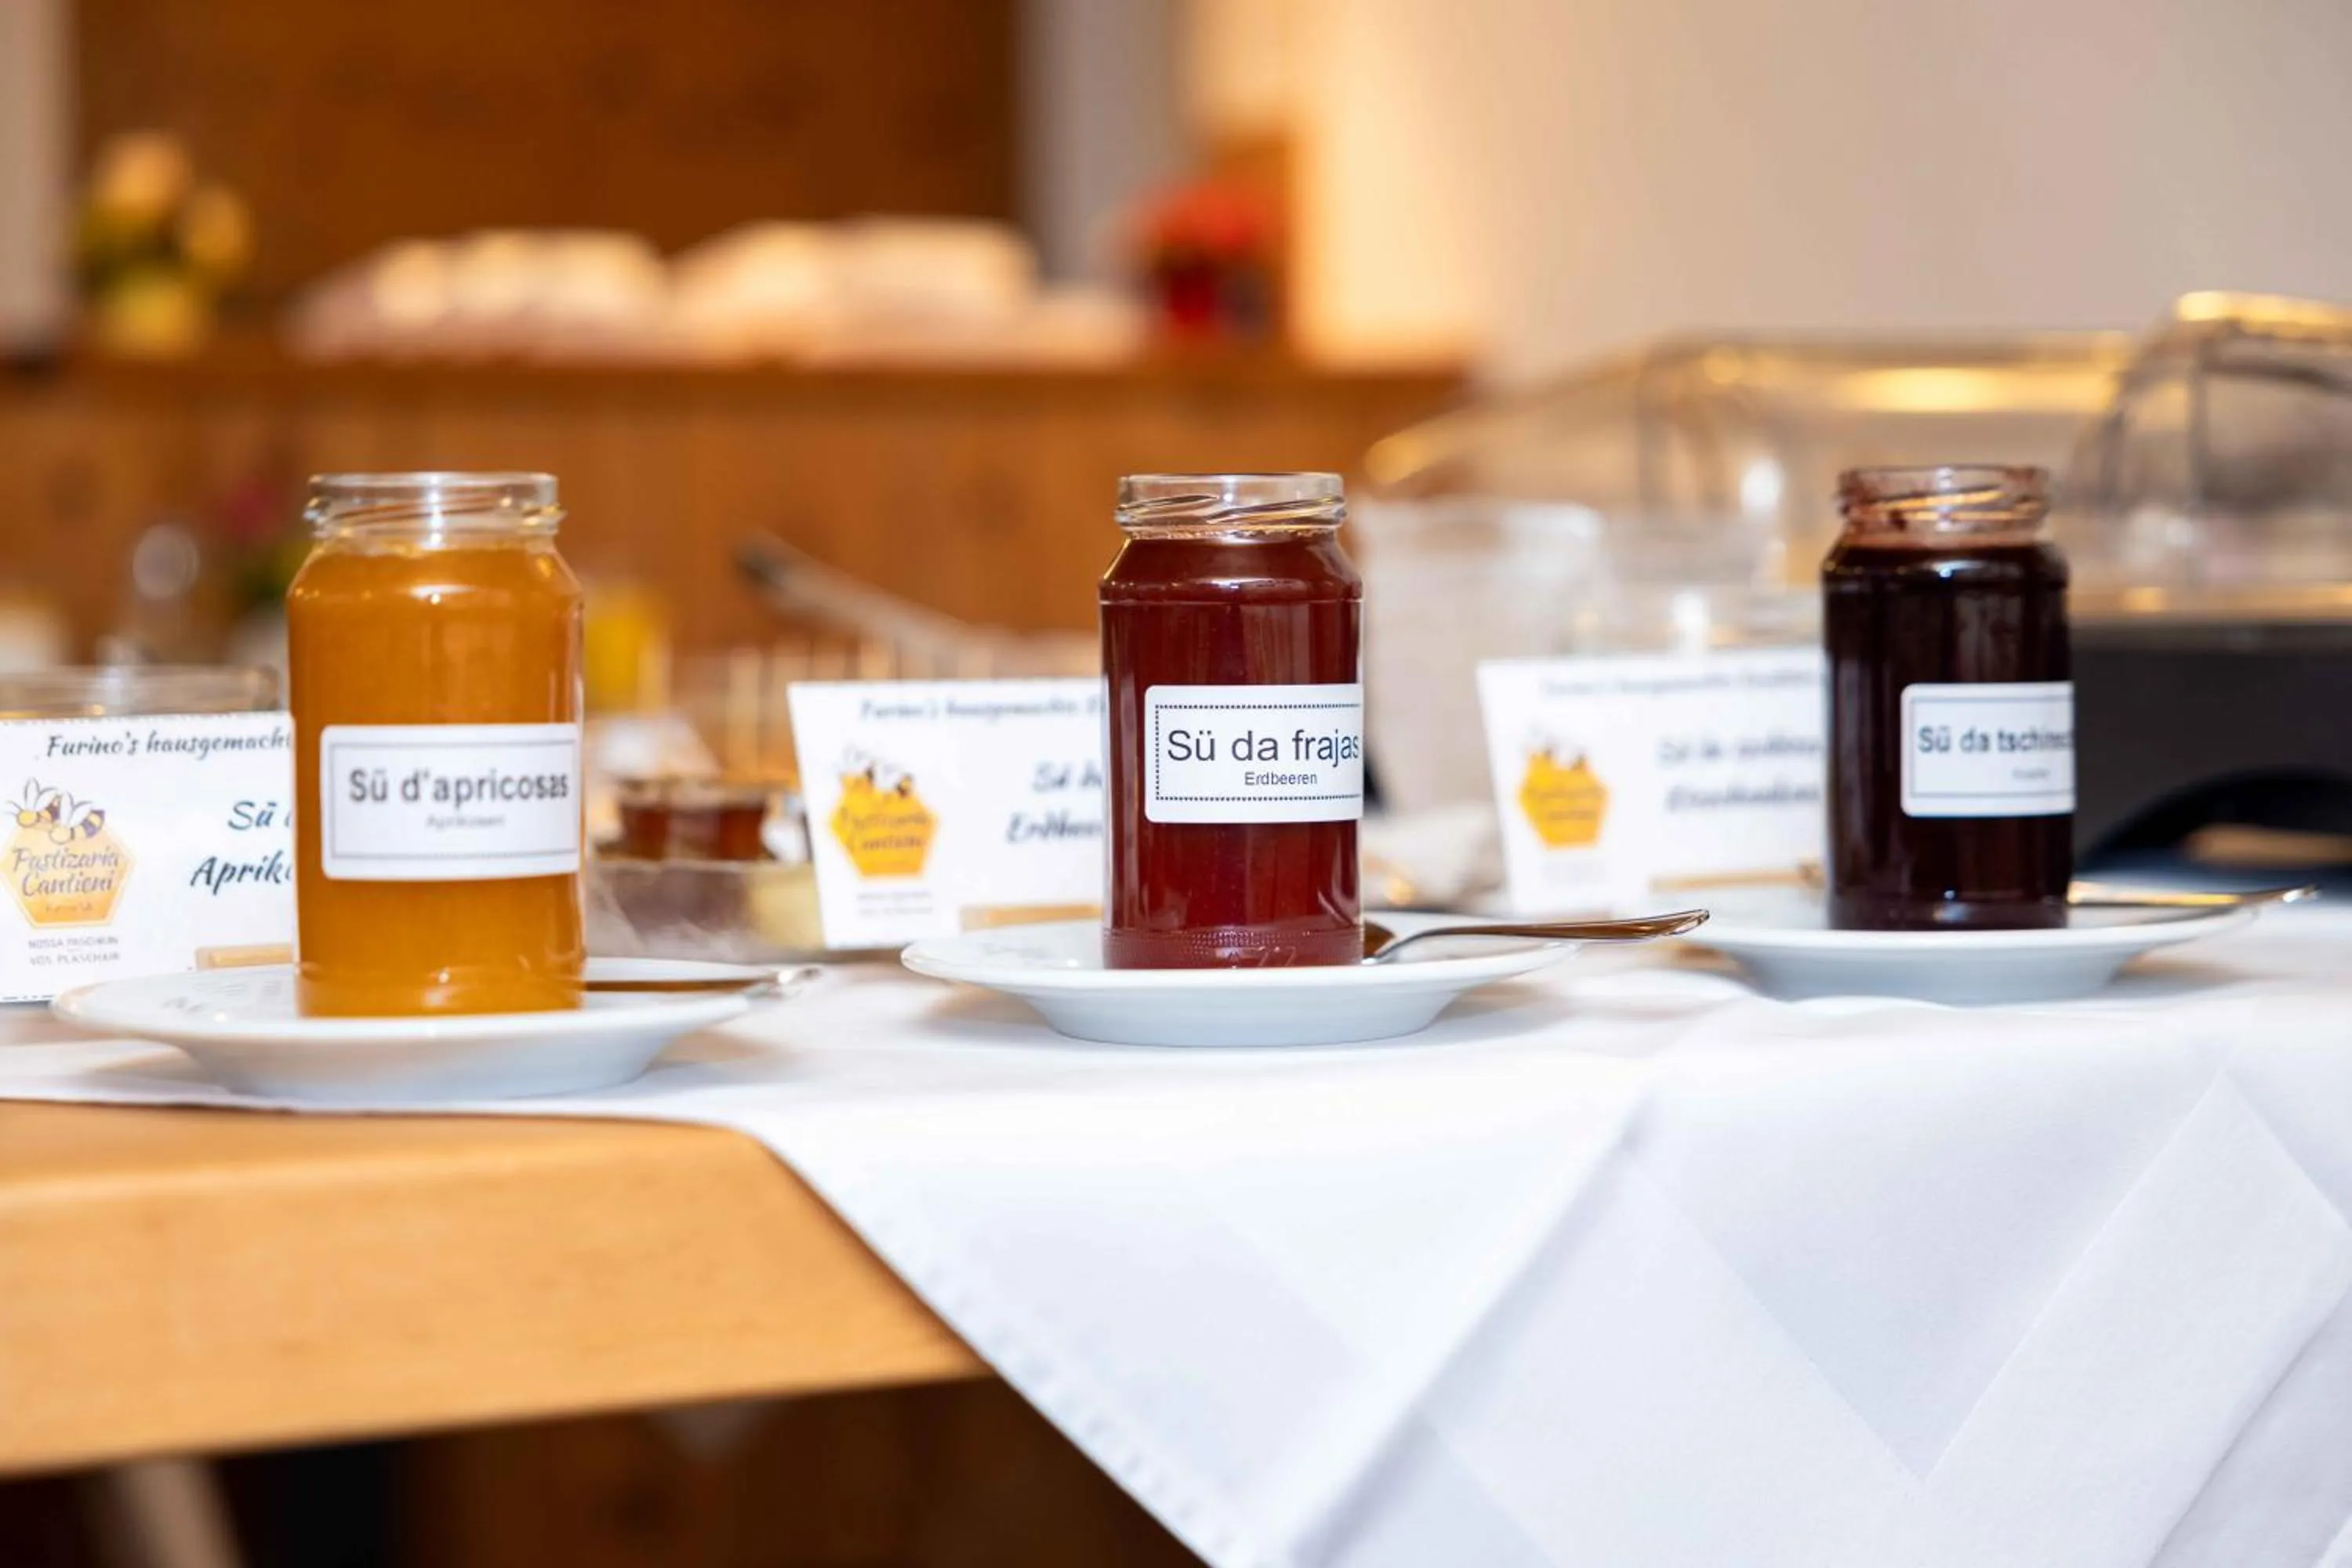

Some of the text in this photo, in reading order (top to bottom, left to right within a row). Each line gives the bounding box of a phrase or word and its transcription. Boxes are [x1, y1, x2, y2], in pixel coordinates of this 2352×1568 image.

[46, 731, 139, 757] Furino's
[1167, 728, 1359, 768] Sü da frajas
[1918, 725, 1951, 753] Sü
[1959, 725, 1991, 753] da
[349, 767, 569, 811] Sü d'apricosas
[1244, 771, 1318, 786] Erdbeeren
[228, 800, 278, 830] Sü
[11, 845, 120, 873] Pastizaria
[22, 869, 115, 896] Cantieni
